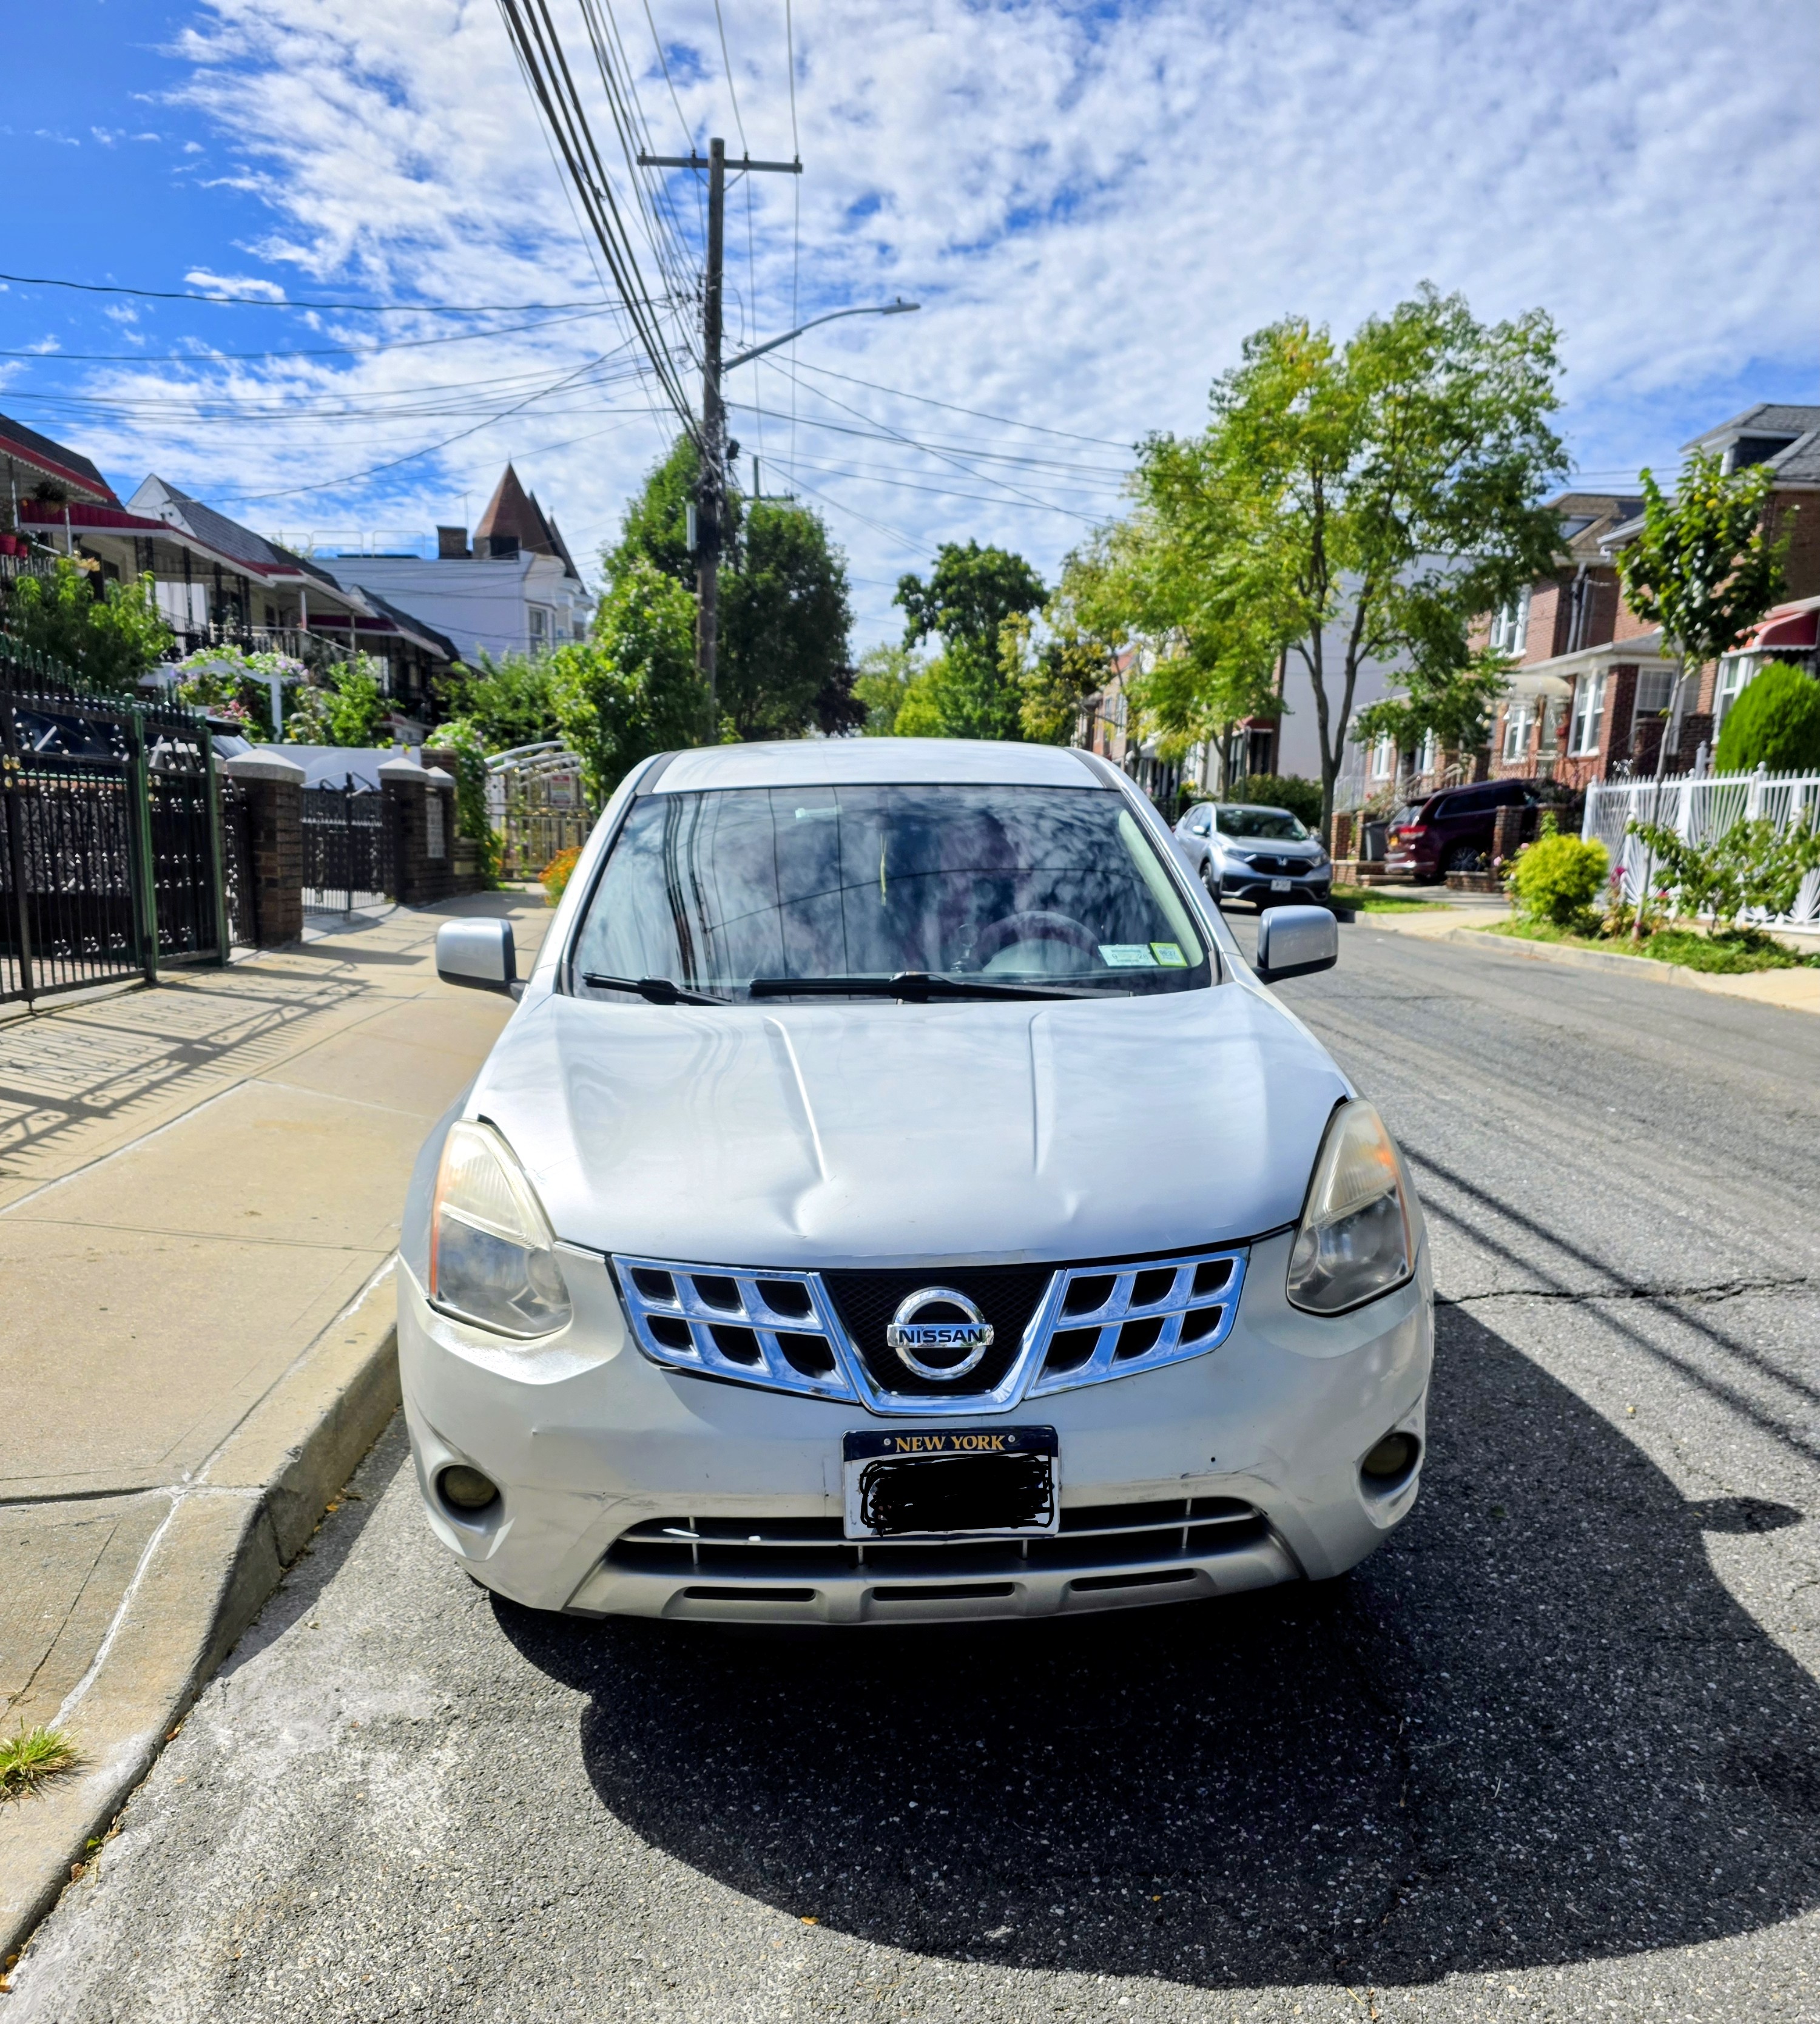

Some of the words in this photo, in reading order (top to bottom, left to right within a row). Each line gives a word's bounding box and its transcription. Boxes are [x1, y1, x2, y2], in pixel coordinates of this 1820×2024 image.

[898, 1329, 983, 1343] NISSAN
[895, 1436, 946, 1452] NEW
[951, 1435, 1006, 1451] YORK
